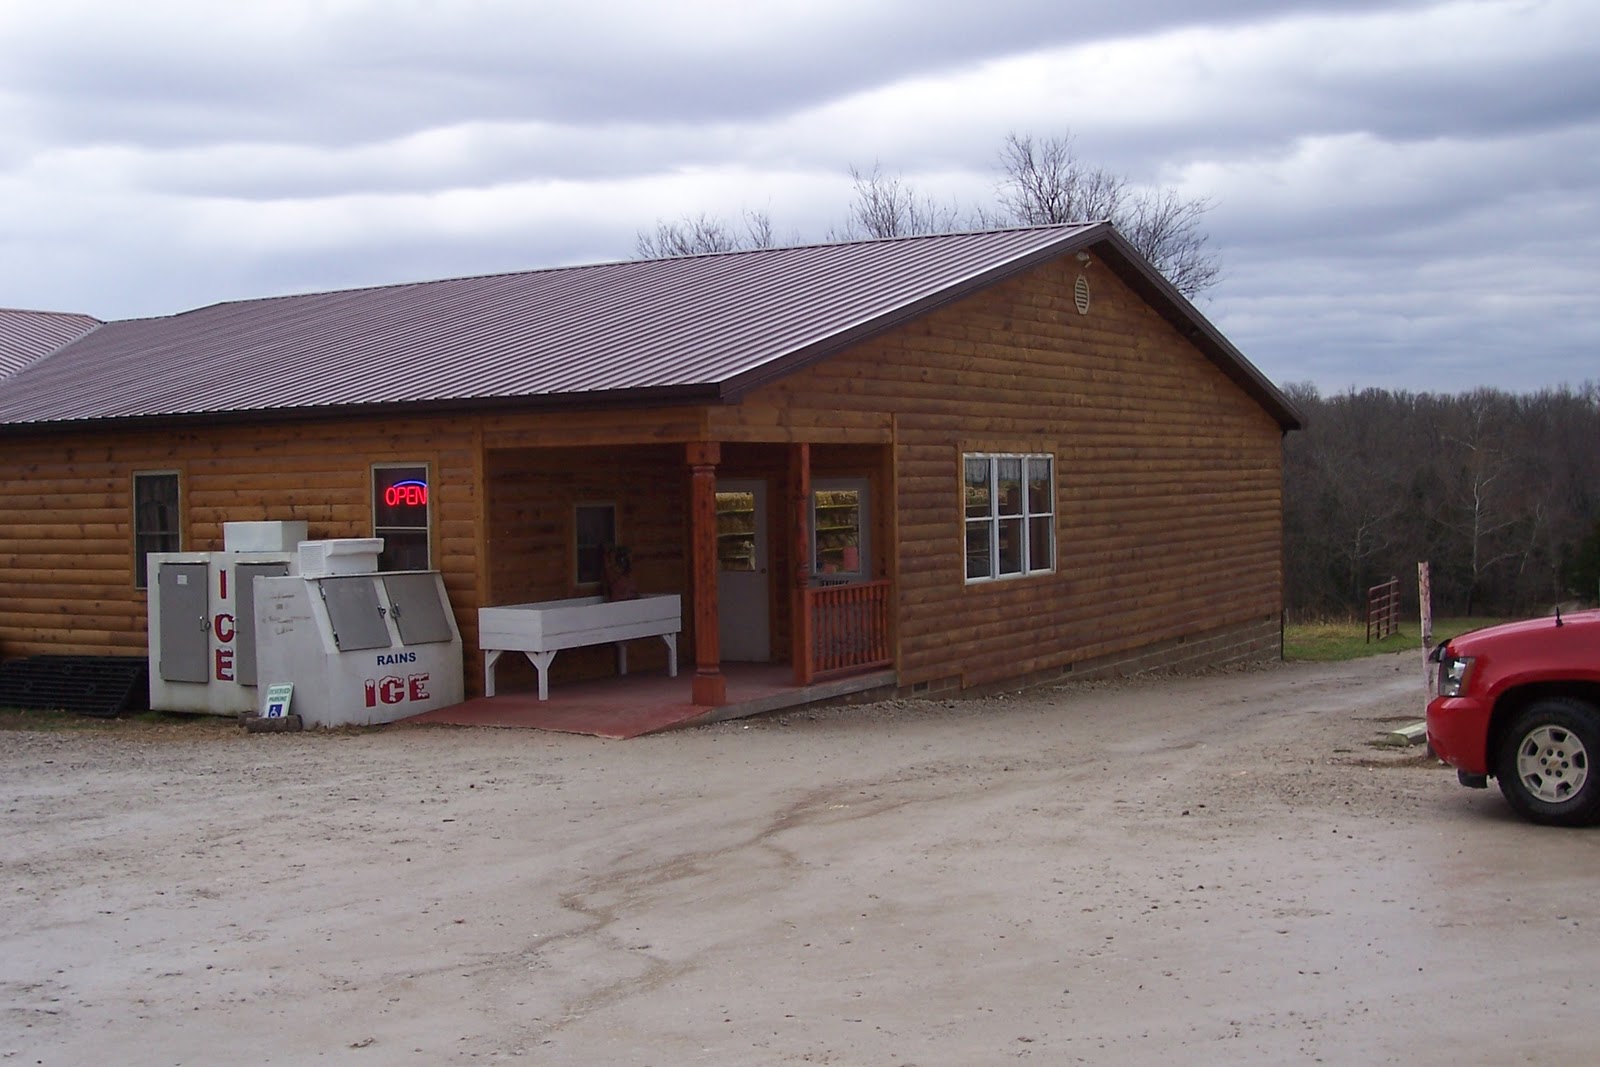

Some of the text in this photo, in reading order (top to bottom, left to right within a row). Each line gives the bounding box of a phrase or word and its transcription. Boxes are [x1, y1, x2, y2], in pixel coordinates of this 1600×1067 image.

[385, 486, 428, 506] OPEN
[214, 569, 235, 682] ICE
[376, 652, 417, 666] RAINS
[364, 672, 430, 708] ICE
